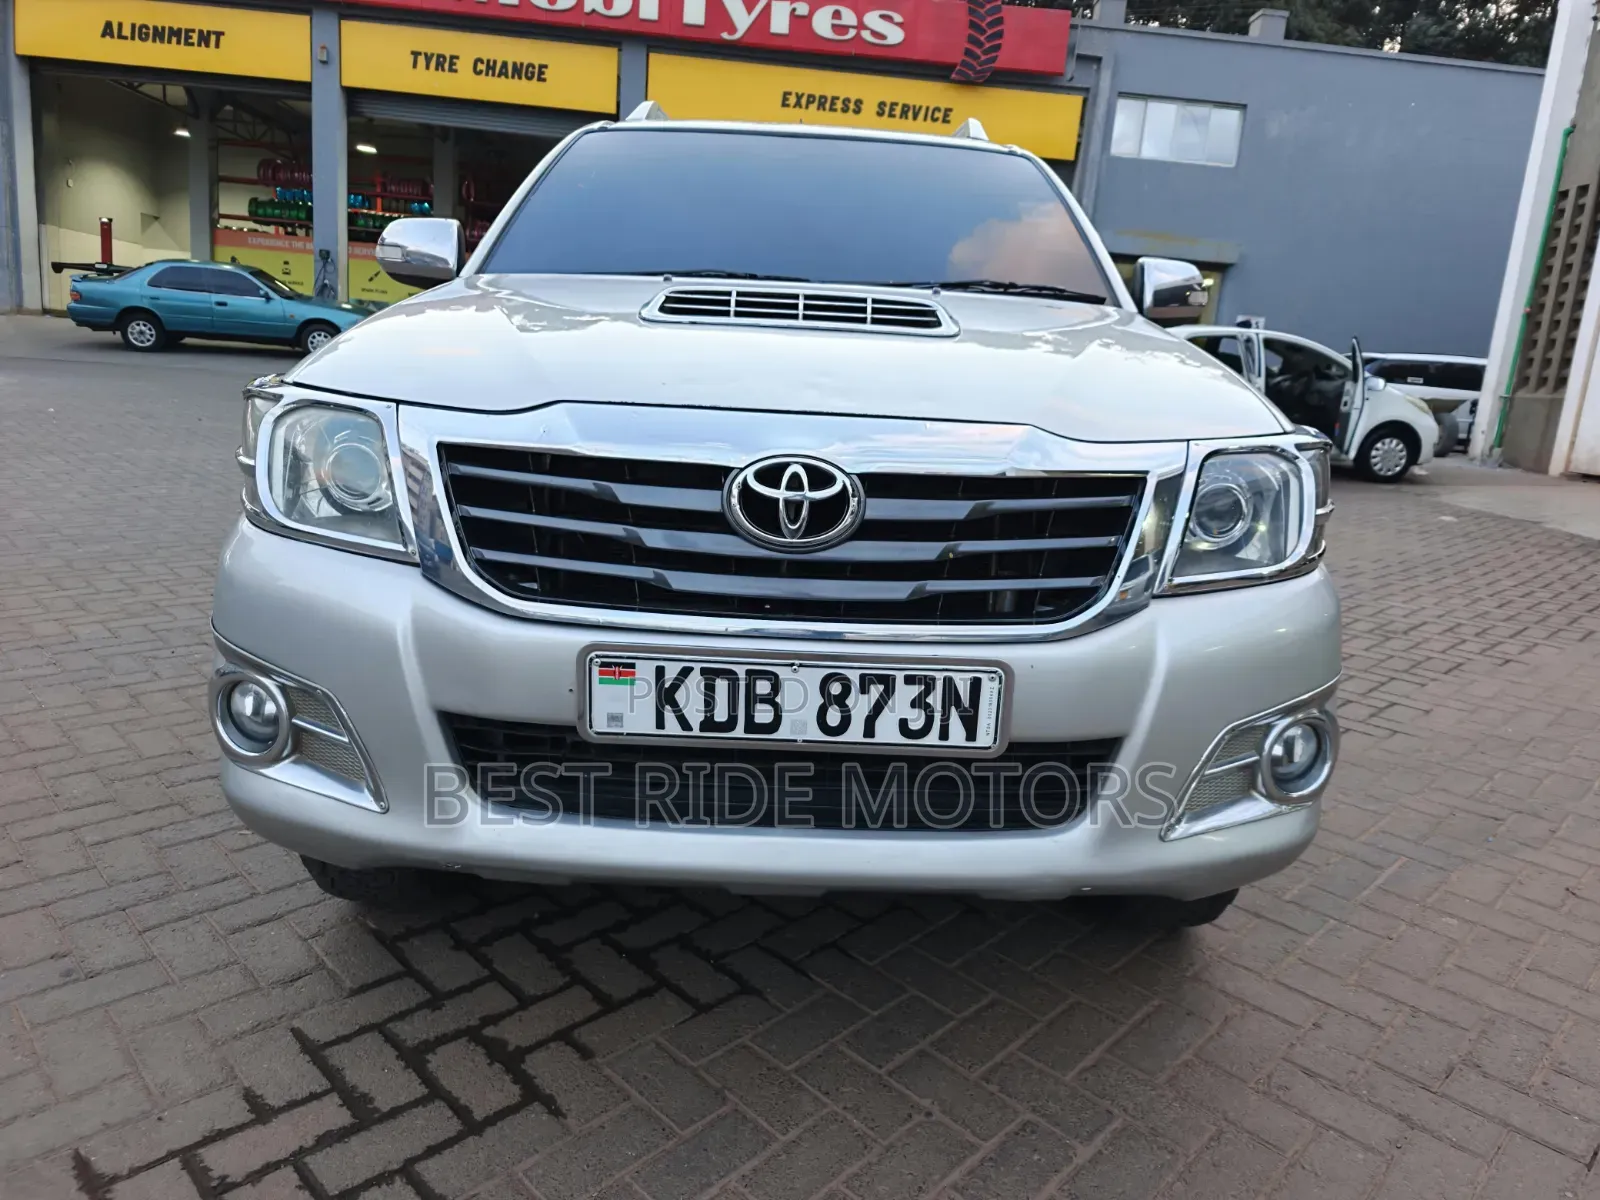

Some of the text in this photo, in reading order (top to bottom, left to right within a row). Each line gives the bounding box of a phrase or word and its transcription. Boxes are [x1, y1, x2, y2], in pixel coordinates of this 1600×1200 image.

[100, 20, 225, 49] ALIGNMENT
[410, 50, 549, 82] TYRE CHANGE
[781, 91, 953, 123] EXPRESS SERVICE
[655, 665, 783, 735] KDB
[816, 672, 982, 742] 873N
